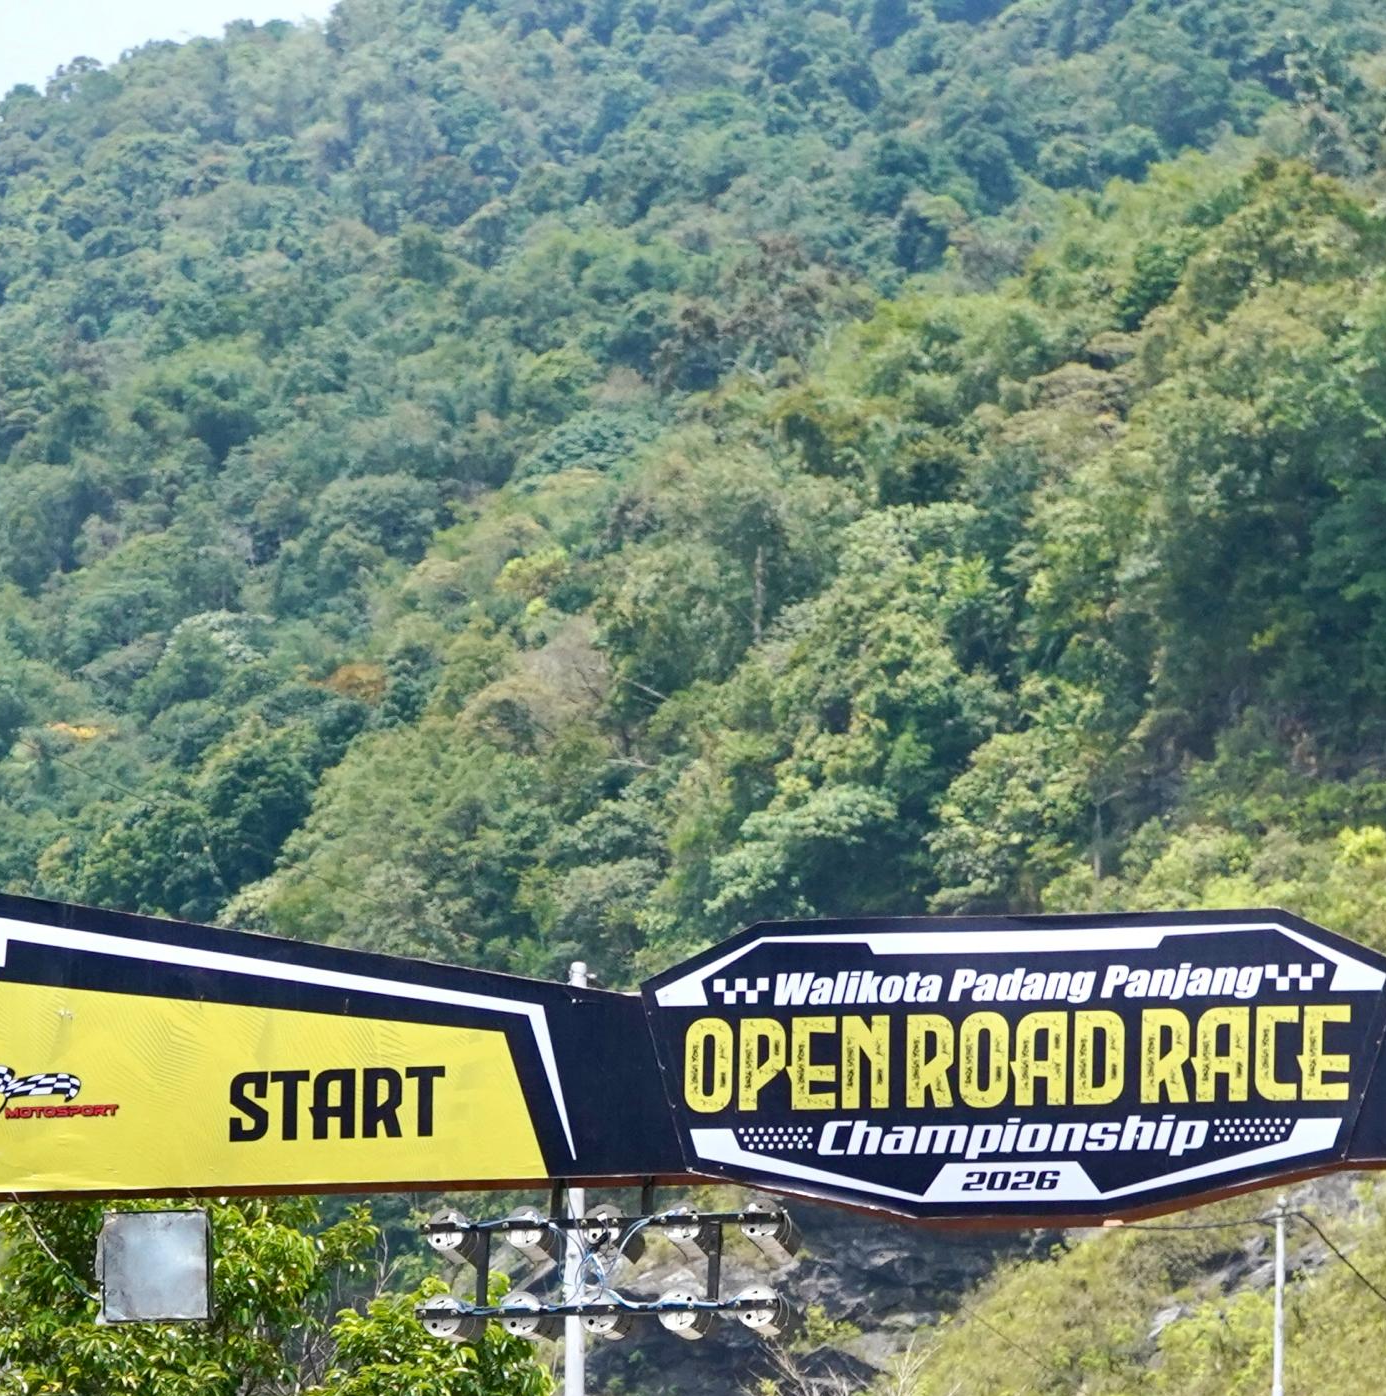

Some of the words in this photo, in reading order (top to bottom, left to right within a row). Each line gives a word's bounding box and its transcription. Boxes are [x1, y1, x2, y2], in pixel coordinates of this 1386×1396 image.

[773, 971, 941, 1006] Walikota
[948, 965, 1094, 1004] Padang
[1100, 962, 1265, 1001] Panjang
[683, 1014, 891, 1113] OPEN
[906, 1008, 1126, 1109] ROAD
[1141, 1004, 1352, 1104] RACE
[4, 1103, 120, 1120] MOTOSPORT
[229, 1065, 446, 1142] START
[817, 1113, 1211, 1160] Championship
[961, 1170, 1062, 1193] 2026
